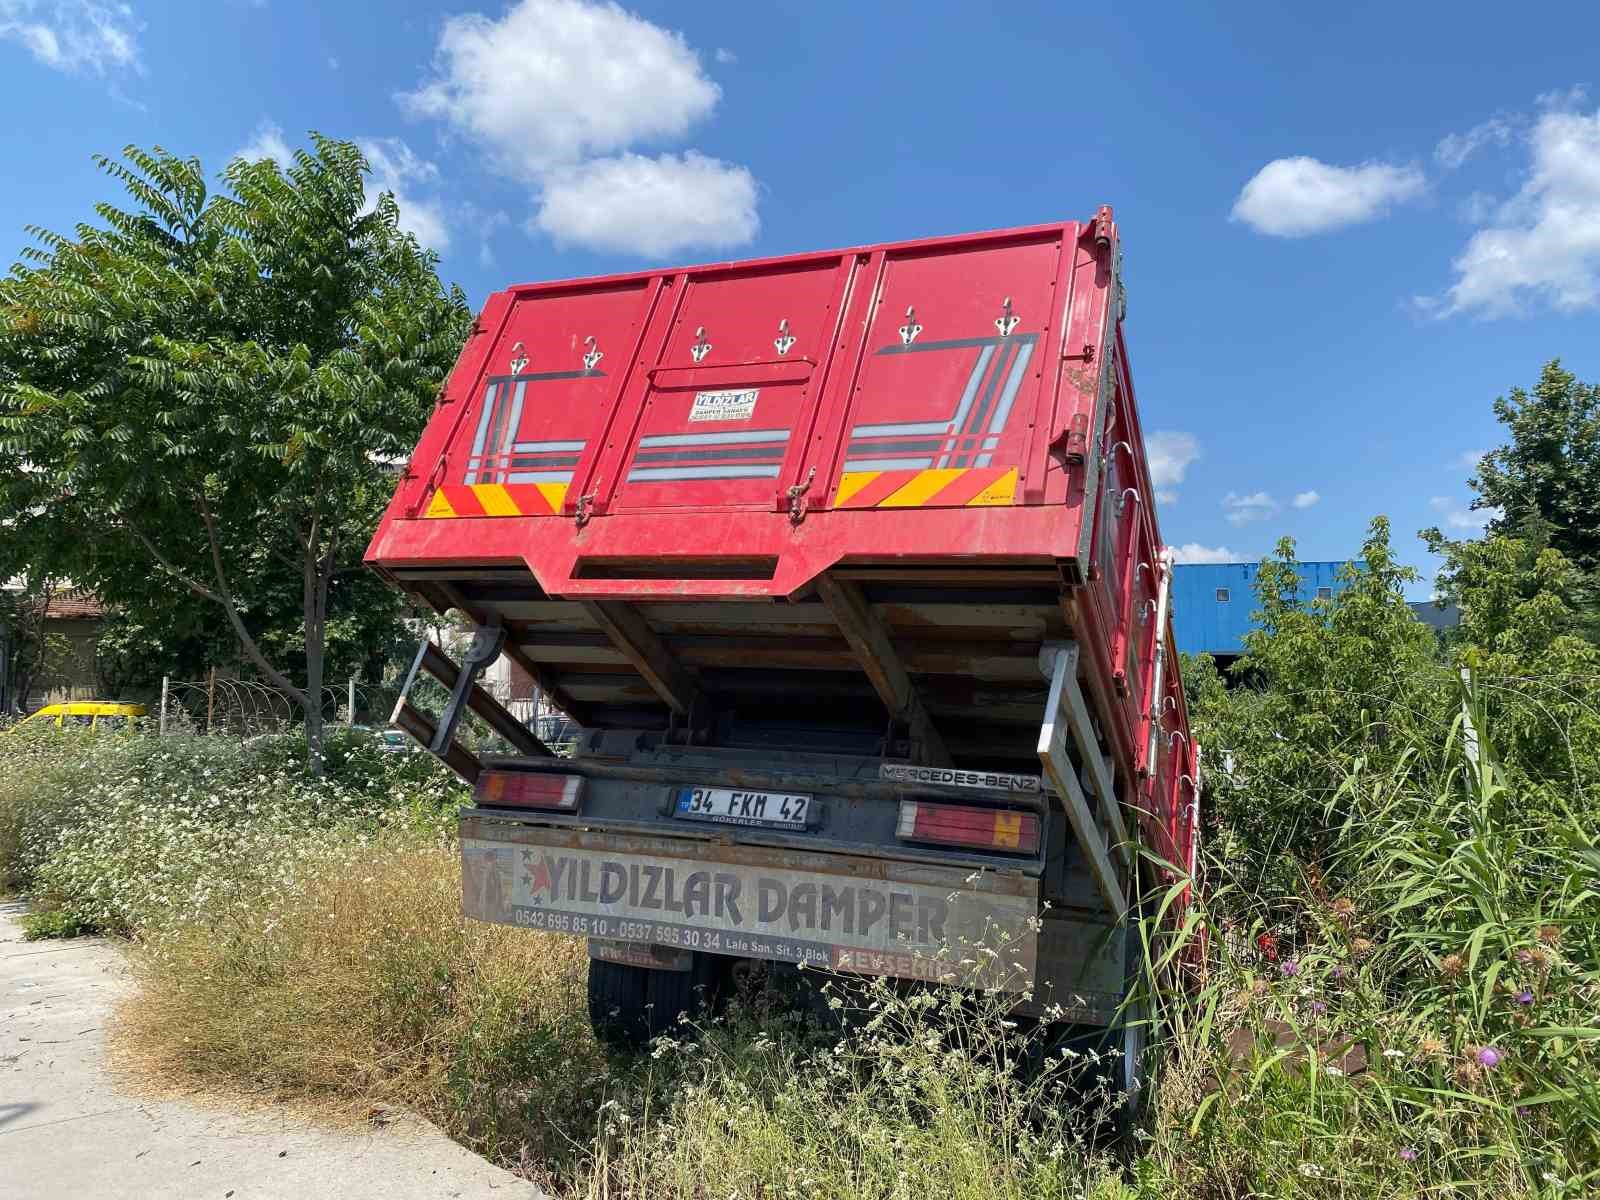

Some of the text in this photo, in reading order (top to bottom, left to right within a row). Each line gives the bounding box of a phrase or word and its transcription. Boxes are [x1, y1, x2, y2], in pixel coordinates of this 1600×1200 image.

[697, 392, 755, 406] YILDIZLAR
[882, 767, 1036, 791] MERCEDES-BENZ
[691, 790, 806, 821] 34 FKM 42
[546, 856, 950, 943] YILDIZLAR DAMPER
[515, 909, 545, 927] 0542
[548, 913, 569, 930] 695
[573, 916, 588, 932] 85
[592, 919, 607, 935] 10
[619, 921, 652, 940] 0537
[683, 929, 700, 947] 30
[704, 932, 720, 949] 34
[726, 938, 748, 951] Lale
